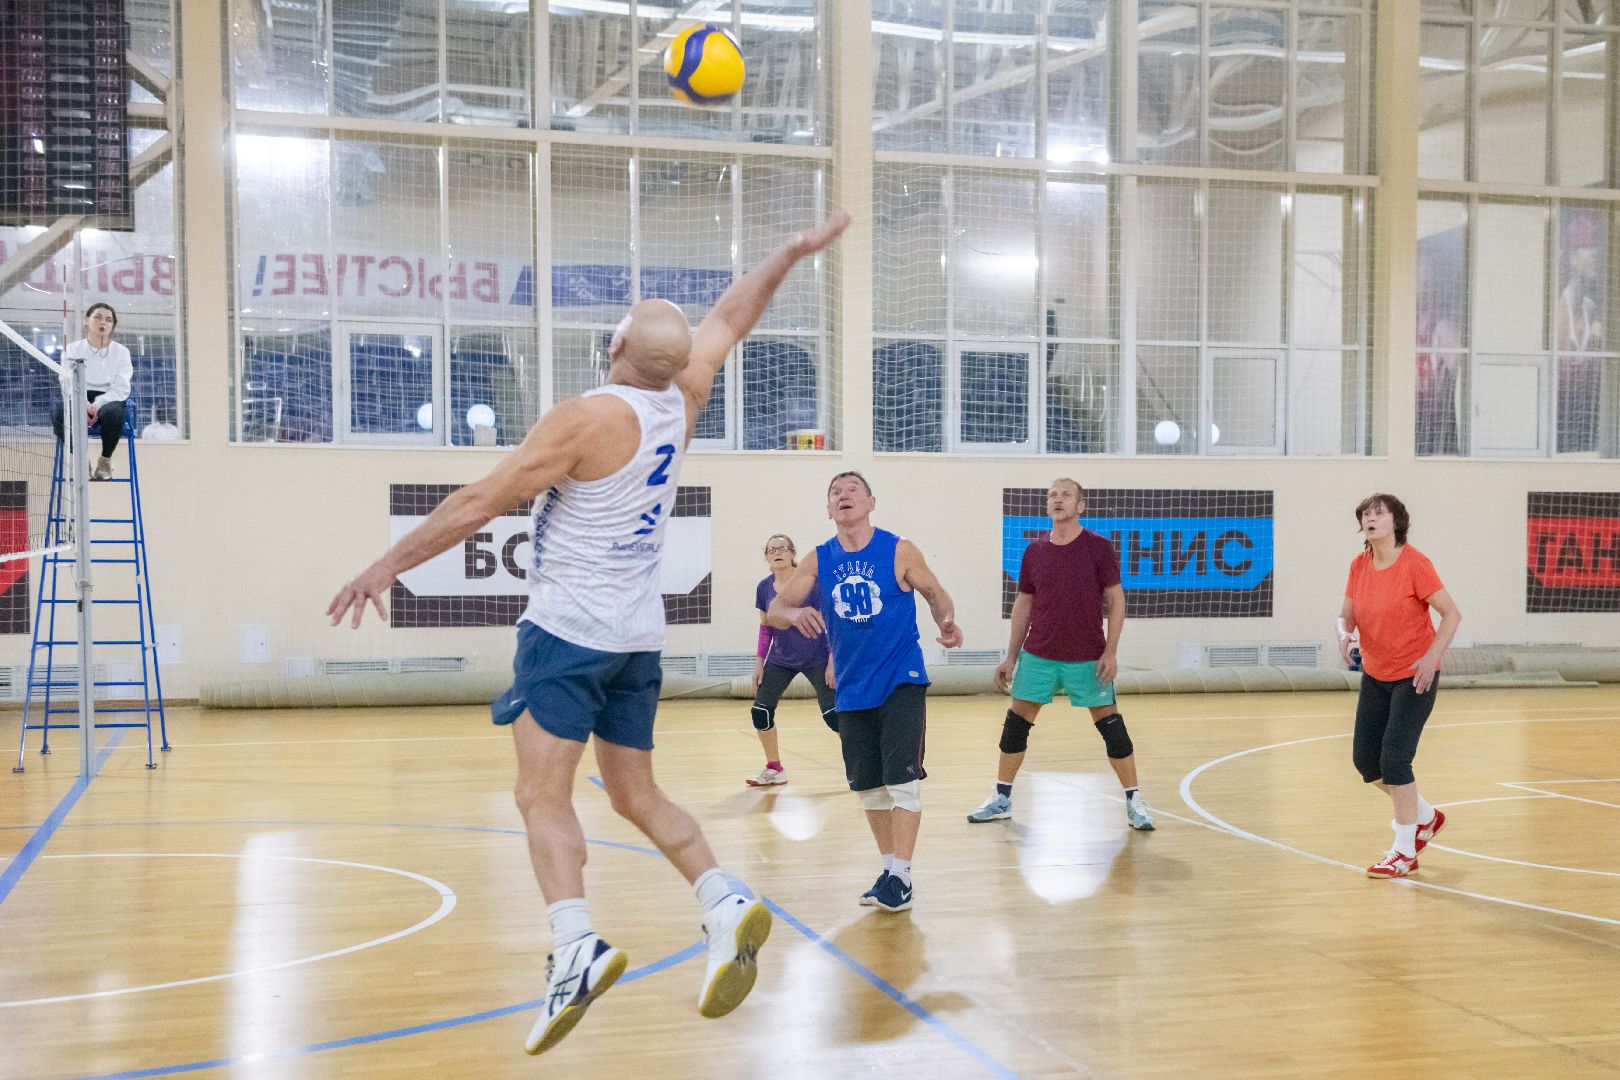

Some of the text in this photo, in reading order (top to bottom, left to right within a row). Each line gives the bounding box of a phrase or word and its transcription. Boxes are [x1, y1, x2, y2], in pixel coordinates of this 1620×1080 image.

[646, 443, 676, 486] 2
[1023, 530, 1254, 577] НИС
[840, 582, 873, 617] 90
